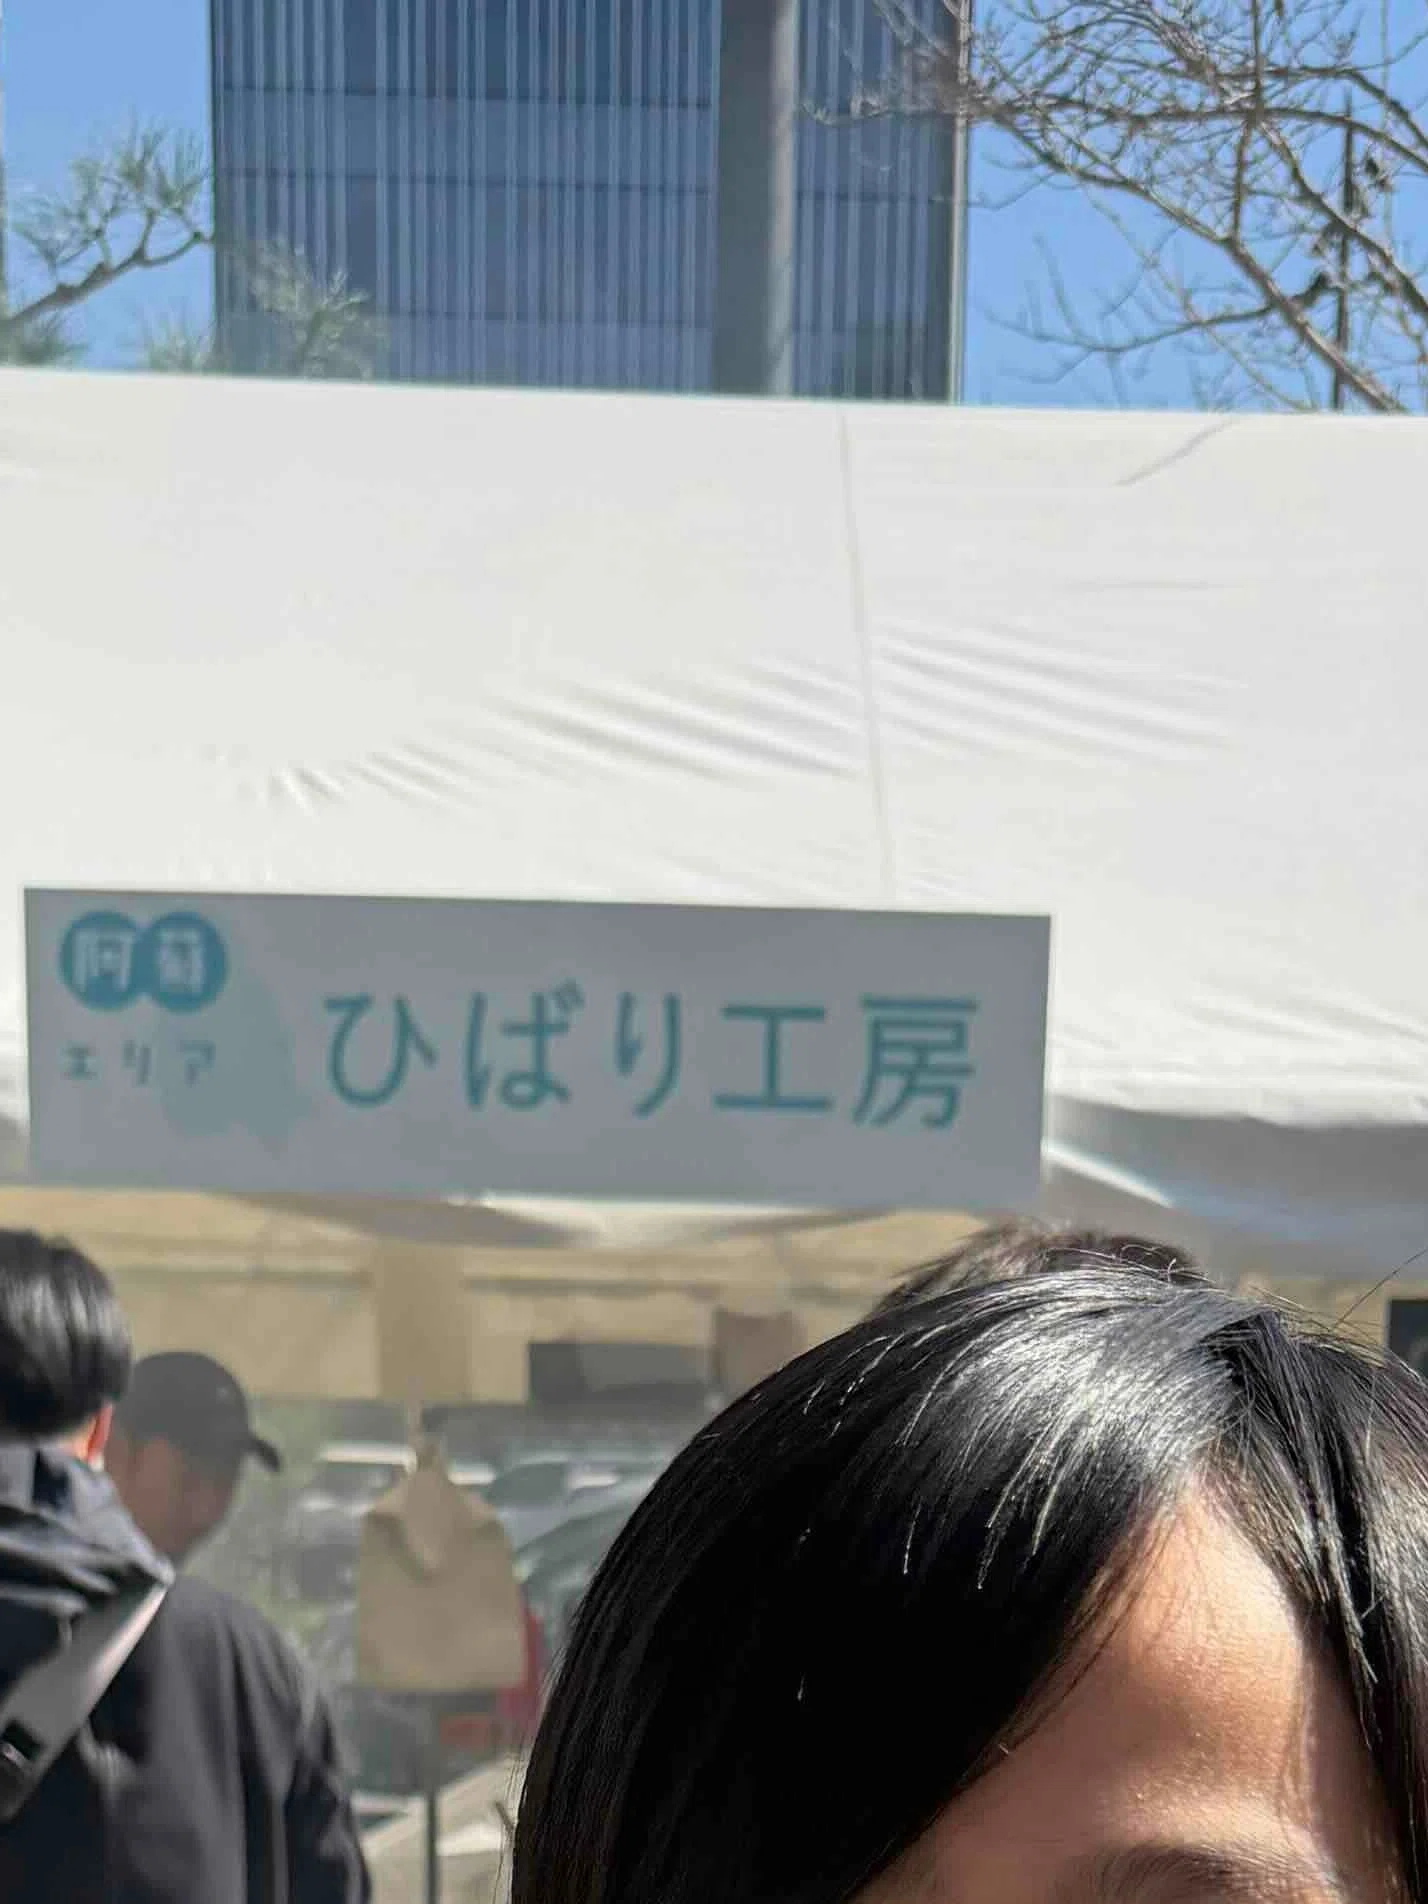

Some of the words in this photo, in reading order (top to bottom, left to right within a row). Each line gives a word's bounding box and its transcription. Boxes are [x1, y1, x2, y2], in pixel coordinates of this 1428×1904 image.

[60, 1040, 216, 1088] エリア
[324, 985, 978, 1130] ひばり工房
